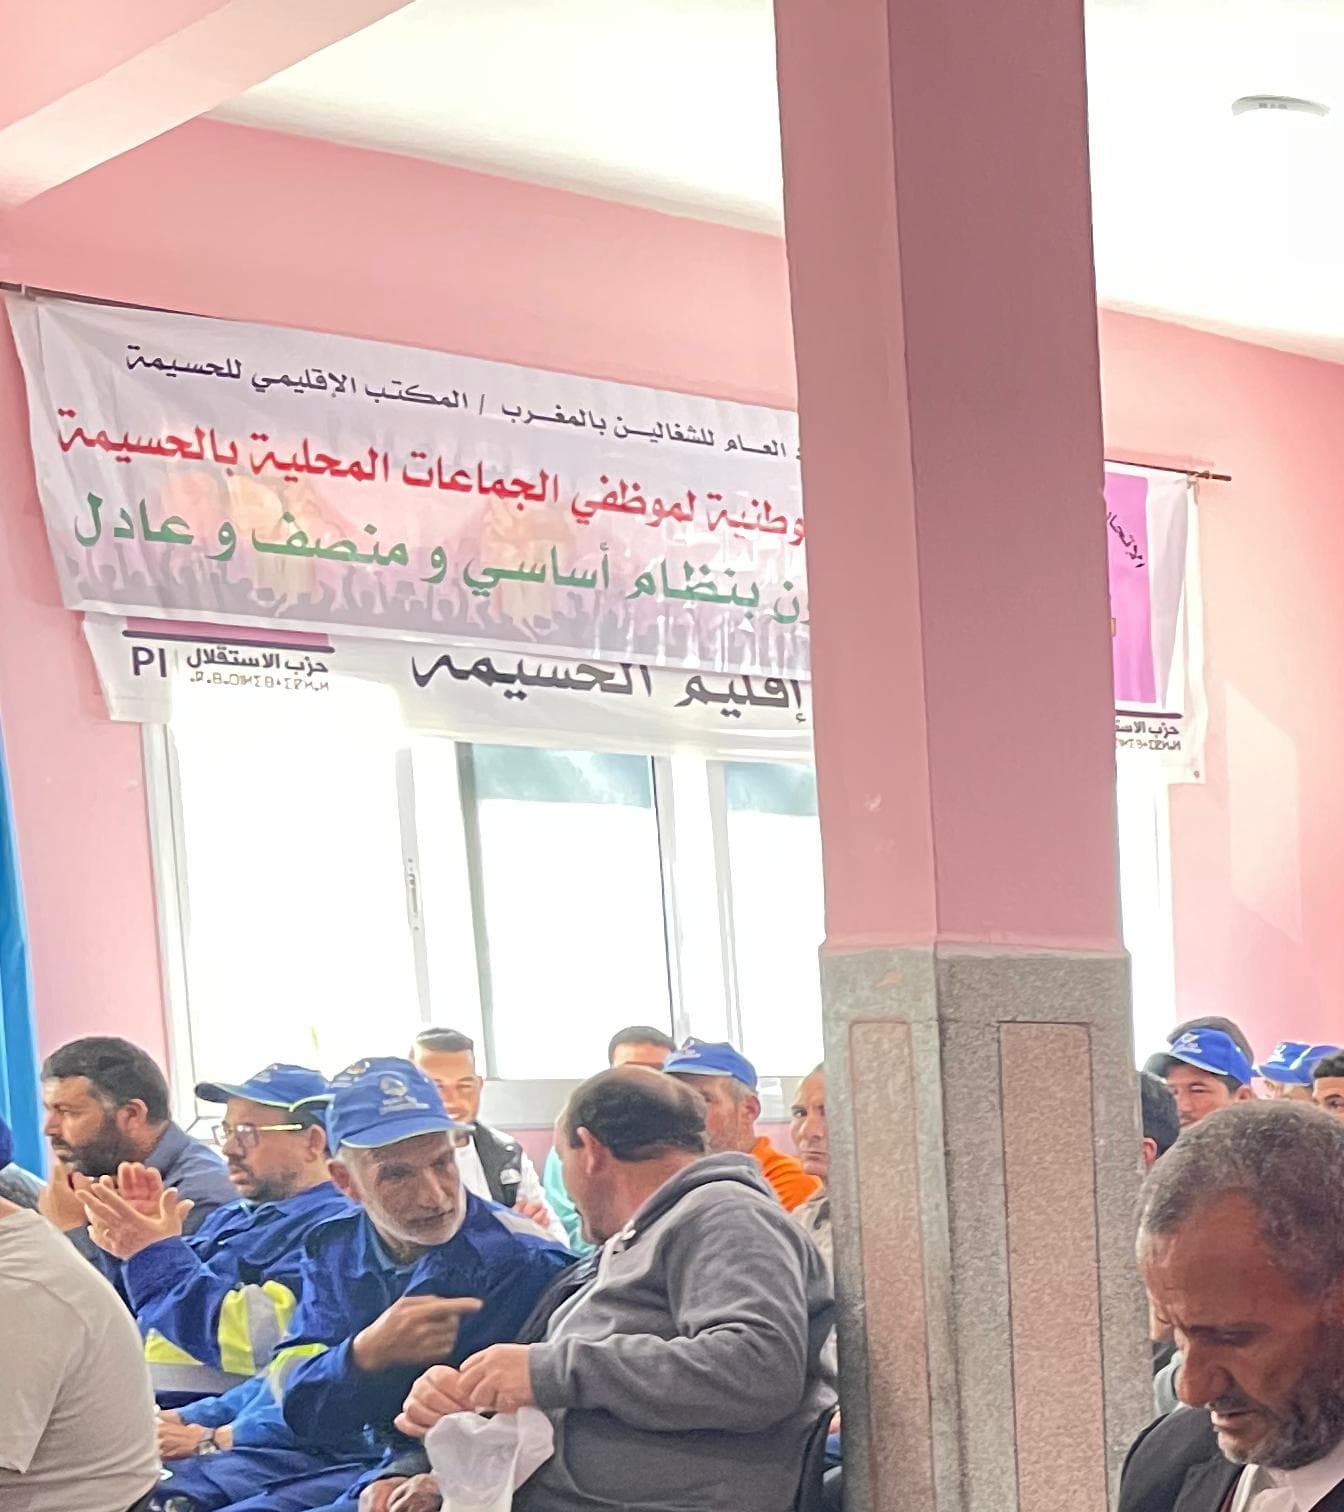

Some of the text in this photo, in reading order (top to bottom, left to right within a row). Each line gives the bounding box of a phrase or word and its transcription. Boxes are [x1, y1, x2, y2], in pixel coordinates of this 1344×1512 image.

[126, 344, 242, 379] للحسيمة
[365, 379, 468, 409] المكتب
[501, 402, 607, 435] بالمغرب
[613, 415, 715, 446] للشغالين
[57, 407, 239, 477] بالحسيمة
[249, 431, 390, 483] المحلية
[402, 450, 559, 512] الجماعات
[570, 474, 696, 527] لموظفي
[73, 491, 195, 548] عادل
[251, 510, 410, 567] منصف
[206, 521, 238, 562] و
[420, 545, 447, 584] و
[462, 541, 610, 598] أساسي
[626, 558, 761, 620] بنظام
[131, 645, 168, 679] PI
[186, 645, 329, 677] حزب الاستقلال
[1147, 722, 1180, 739] حزب
